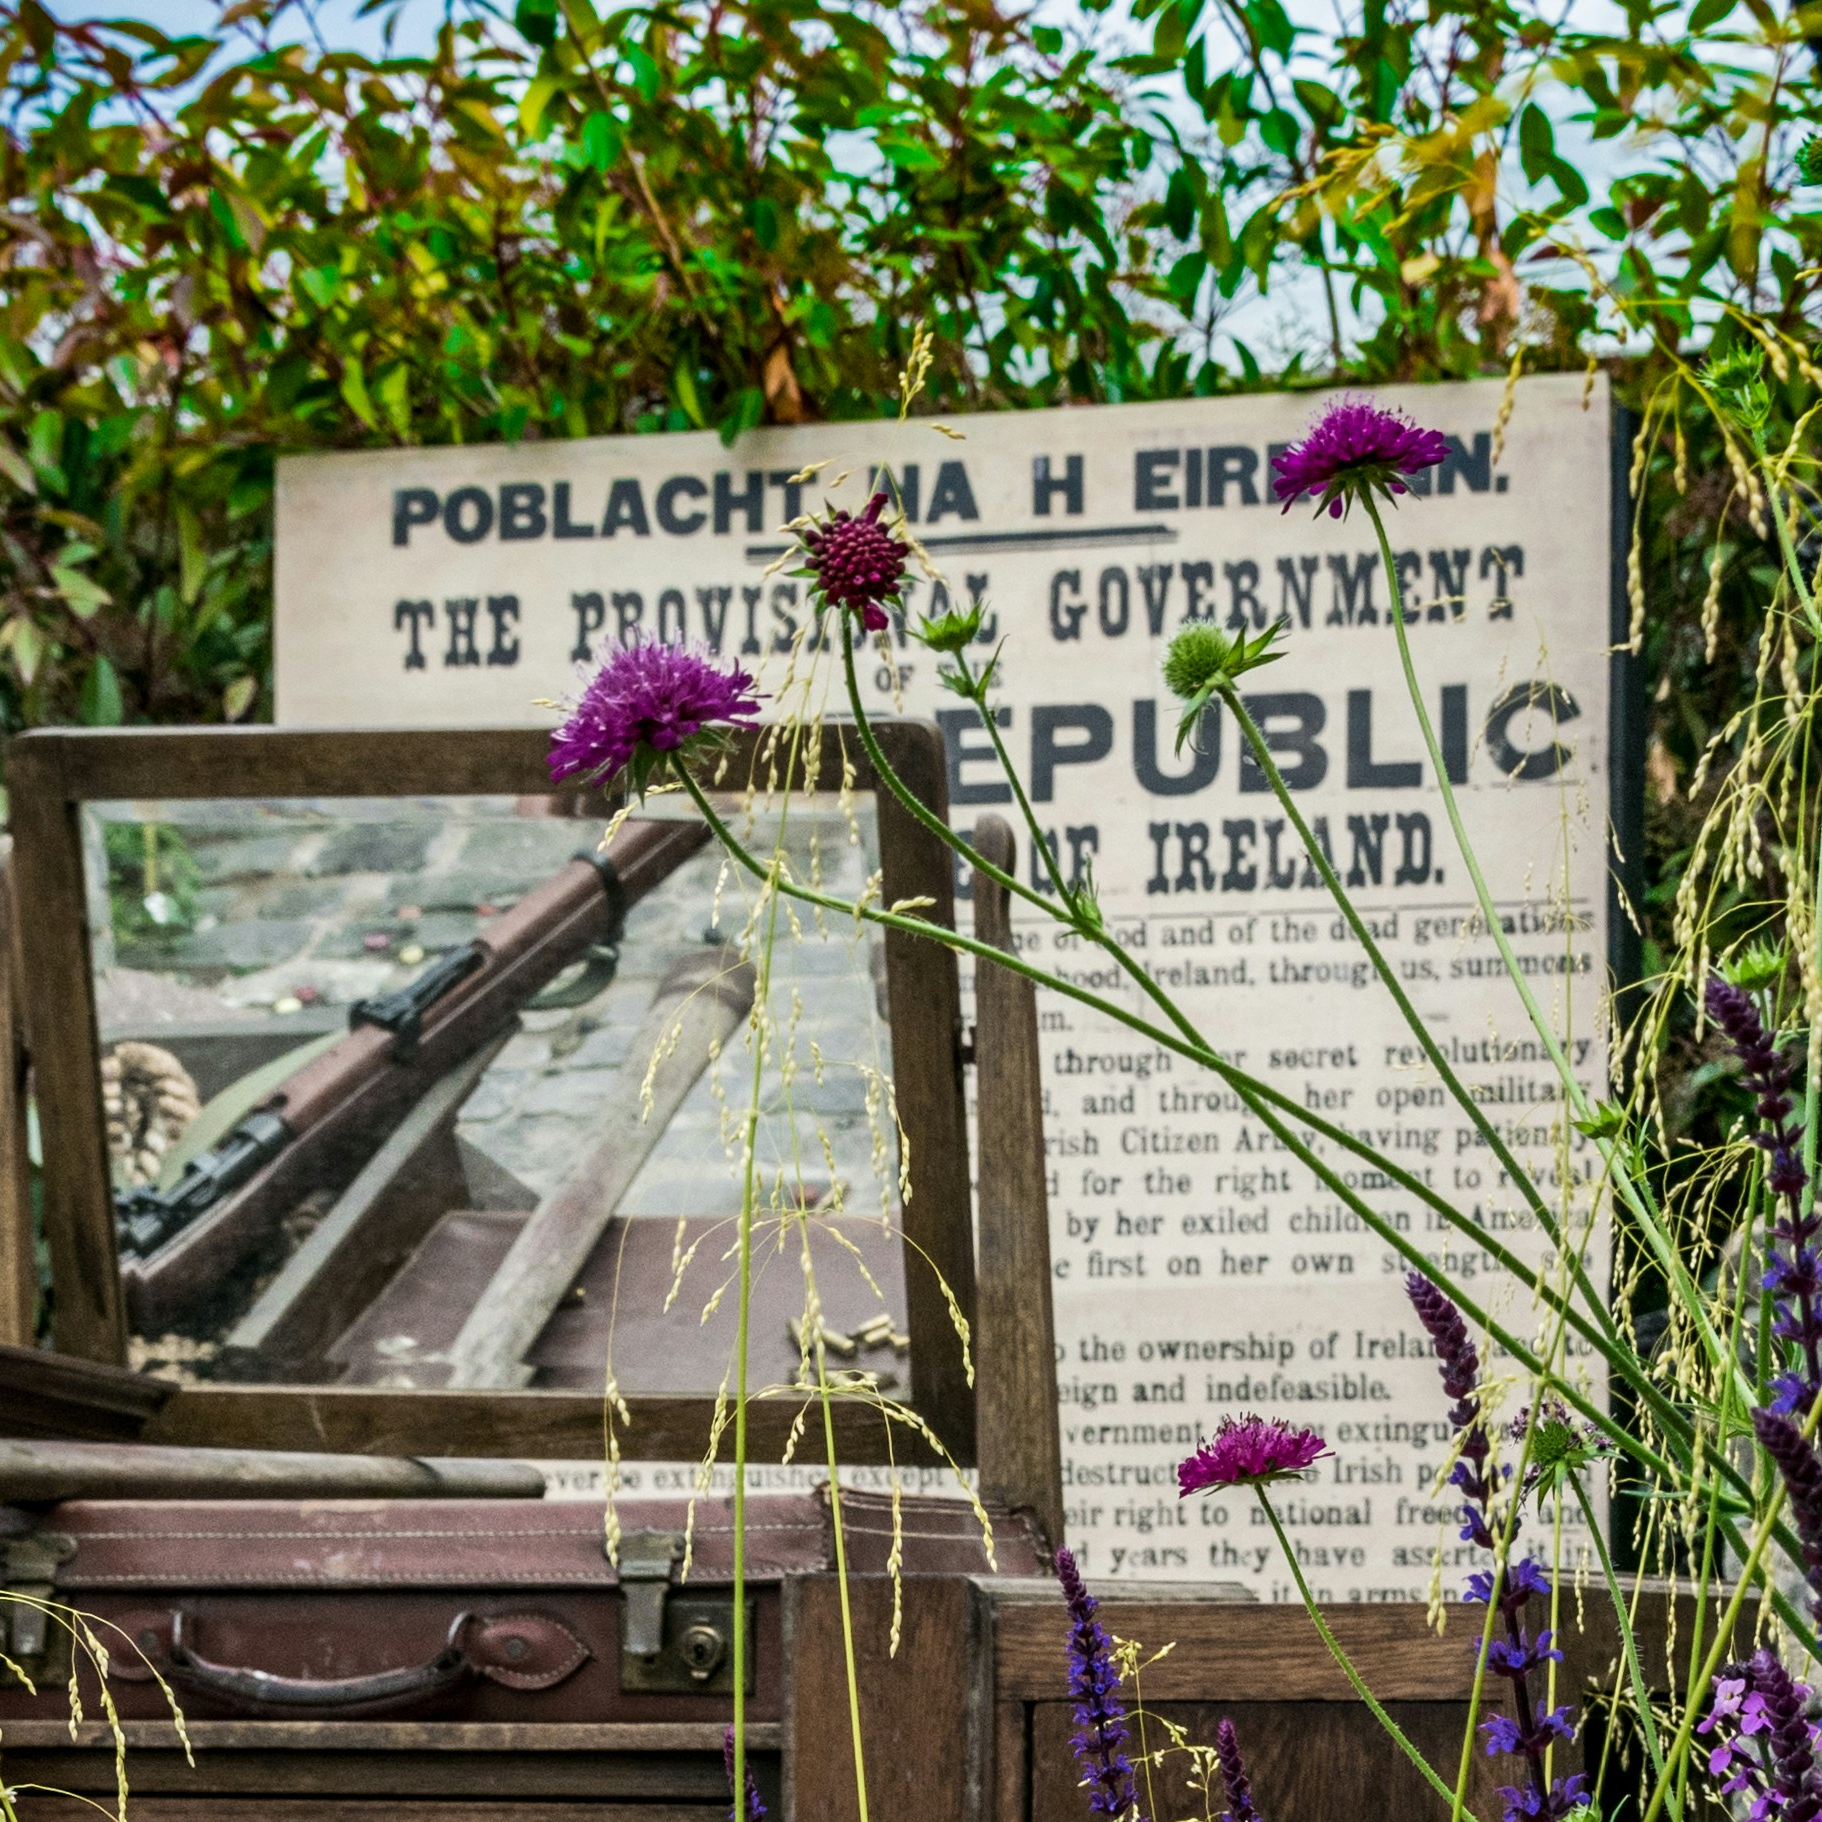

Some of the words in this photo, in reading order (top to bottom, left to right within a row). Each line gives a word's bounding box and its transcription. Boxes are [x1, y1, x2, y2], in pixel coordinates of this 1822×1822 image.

[392, 470, 817, 547] POBLACHT
[869, 459, 981, 525] NA
[1033, 455, 1083, 516] H
[1135, 432, 1510, 509] EIRN.
[393, 593, 523, 670] THE
[570, 572, 997, 664] PROVISNAL
[1048, 544, 1524, 641] GOVERNMENT
[875, 663, 914, 692] OF
[935, 679, 1582, 807] EPUBLIC
[1030, 824, 1099, 897] OF
[1146, 811, 1444, 896] IRELAND.
[1162, 919, 1215, 946] and
[1228, 916, 1258, 944] of
[1270, 912, 1318, 943] the
[1330, 911, 1399, 942] dad
[1400, 957, 1441, 982] us,
[1449, 951, 1593, 979] summons
[1053, 1046, 1173, 1081] through
[1268, 1045, 1359, 1068] secret
[1081, 1087, 1136, 1115] and
[1305, 1082, 1354, 1109] her
[1376, 1085, 1445, 1115] open
[1044, 1128, 1099, 1156] rish
[1120, 1125, 1221, 1155] Citizen
[1081, 1167, 1121, 1195] for
[1143, 1166, 1193, 1195] the
[1215, 1164, 1292, 1198] right
[1453, 1164, 1480, 1188] to
[1066, 1208, 1100, 1243] by
[1115, 1208, 1164, 1236] her
[1181, 1204, 1270, 1234] exiled
[1086, 1249, 1147, 1278] first
[1166, 1253, 1201, 1277] on
[1219, 1247, 1270, 1276] her
[1291, 1252, 1355, 1275] own
[1079, 1332, 1127, 1363] the
[1137, 1331, 1295, 1366] ownership
[1308, 1330, 1340, 1360] of
[1132, 1374, 1186, 1403] and
[1205, 1371, 1393, 1404] indefeasible.
[1064, 1419, 1203, 1446] vernment
[1062, 1459, 1178, 1488] destruct
[1333, 1456, 1404, 1485] Irish
[1114, 1500, 1188, 1535] right
[1200, 1501, 1230, 1527] to
[1110, 1545, 1189, 1575] years
[1209, 1539, 1272, 1574] they
[1294, 1540, 1367, 1567] have
[1348, 1586, 1423, 1603] arms
